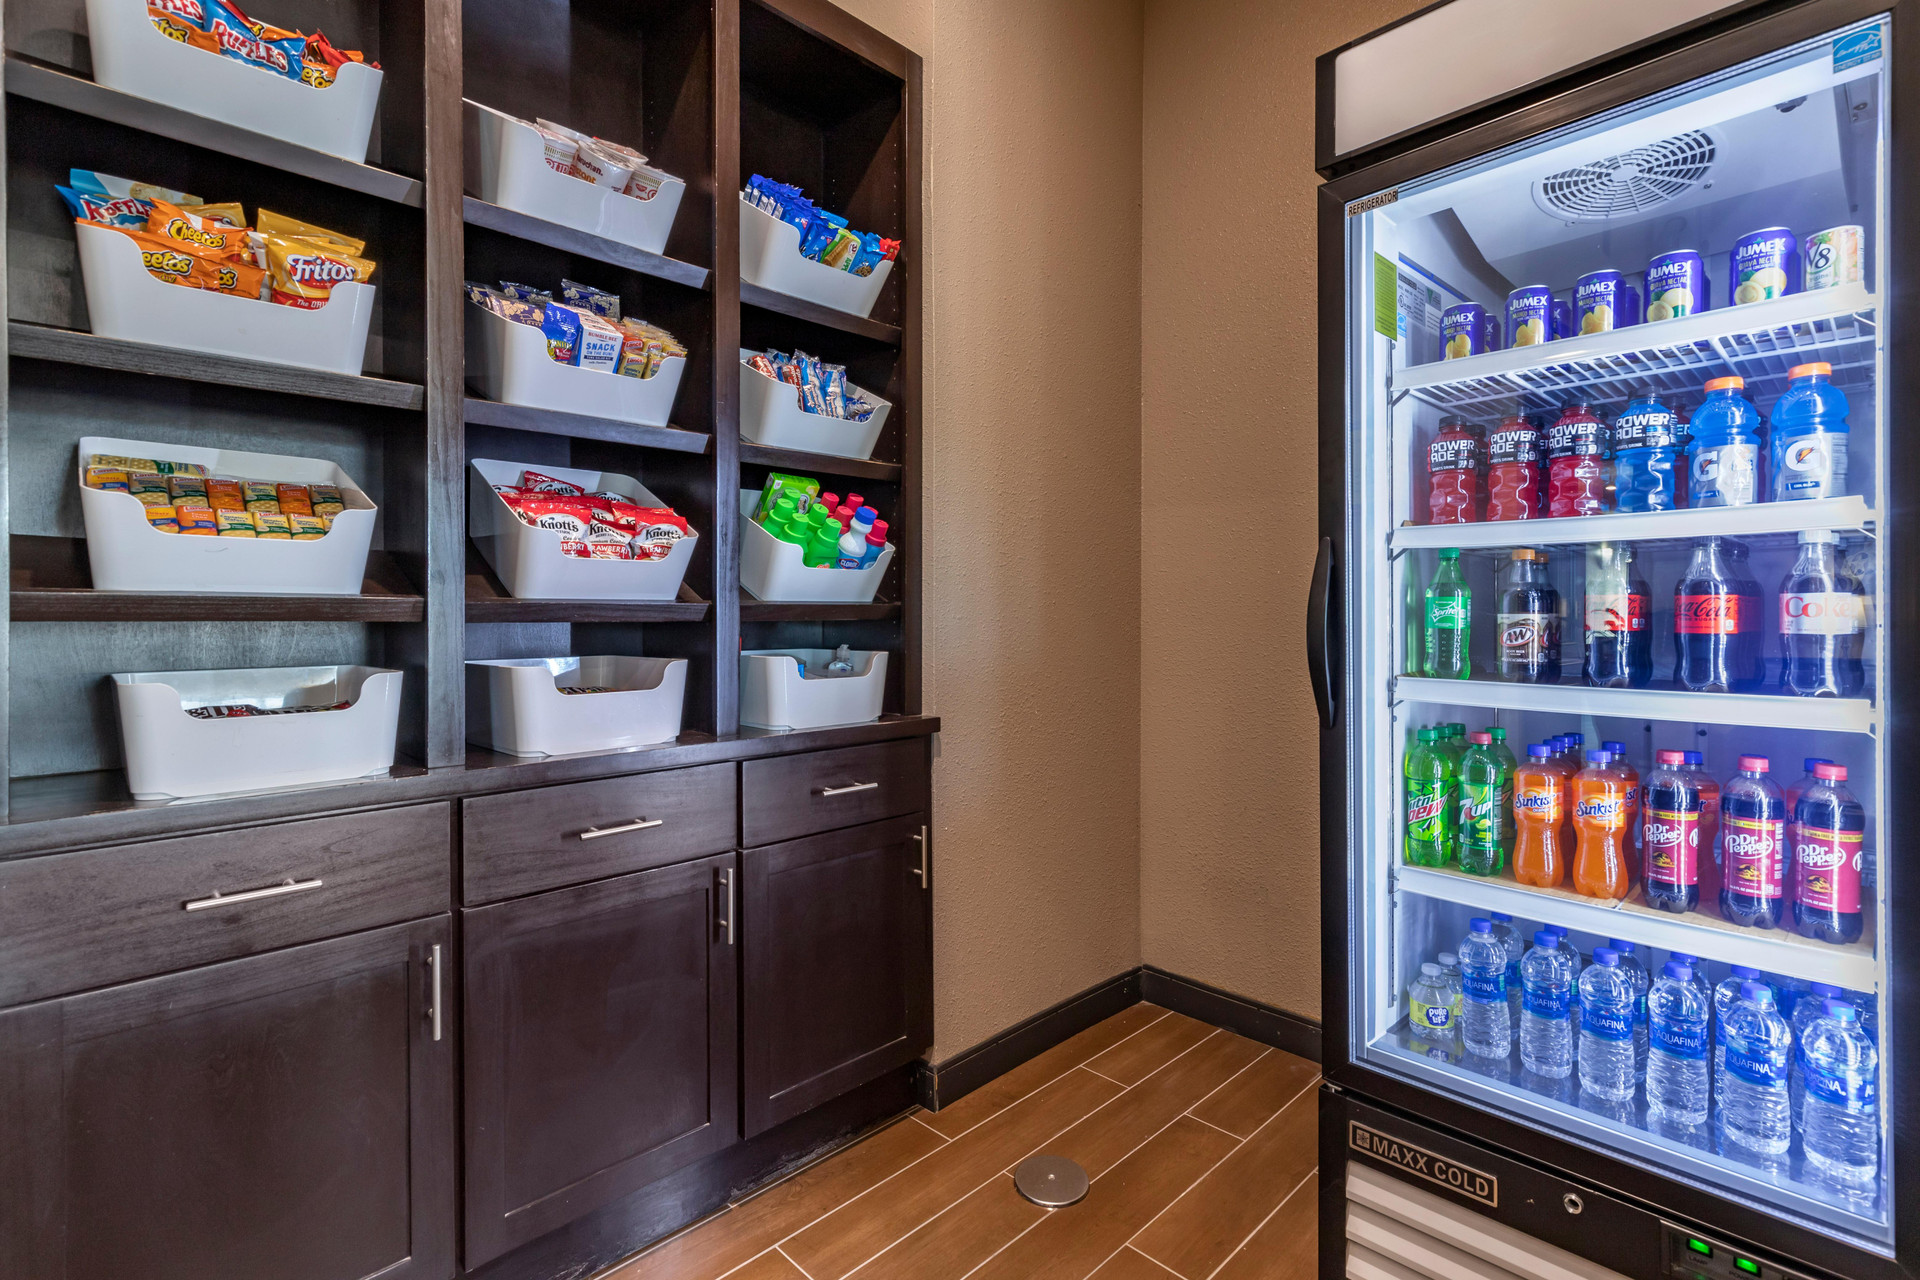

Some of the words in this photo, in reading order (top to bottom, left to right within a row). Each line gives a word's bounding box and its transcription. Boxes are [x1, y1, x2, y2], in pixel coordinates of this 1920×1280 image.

[213, 19, 288, 72] RUFFLES
[1348, 190, 1397, 216] REFRIGERATOR
[169, 219, 225, 248] Cheetos
[1736, 238, 1786, 260] JUMEX
[1807, 242, 1831, 269] V8
[287, 254, 355, 281] Fritos
[1648, 260, 1692, 280] JUMEX
[1576, 280, 1617, 298] JUMEX
[1510, 295, 1548, 311] JUMEX
[1441, 311, 1475, 327] JUMEX
[586, 342, 616, 352] SNACK
[1616, 413, 1670, 427] POWER
[1491, 430, 1537, 444] POWER
[1549, 422, 1598, 438] POWER
[1431, 440, 1475, 452] POWER
[540, 519, 579, 532] Knott's
[1576, 801, 1619, 817] Sunkist
[1644, 824, 1680, 843] Pepper
[1654, 824, 1669, 833] Dr
[1739, 834, 1758, 845] Dr
[1809, 844, 1828, 855] Dr
[1586, 1012, 1625, 1033] AQUAFINA
[1656, 1031, 1700, 1049] AQUAFINA
[1727, 1053, 1771, 1075] AQUAFINA
[1373, 1136, 1428, 1173] MAXX
[1434, 1161, 1489, 1197] COLD
